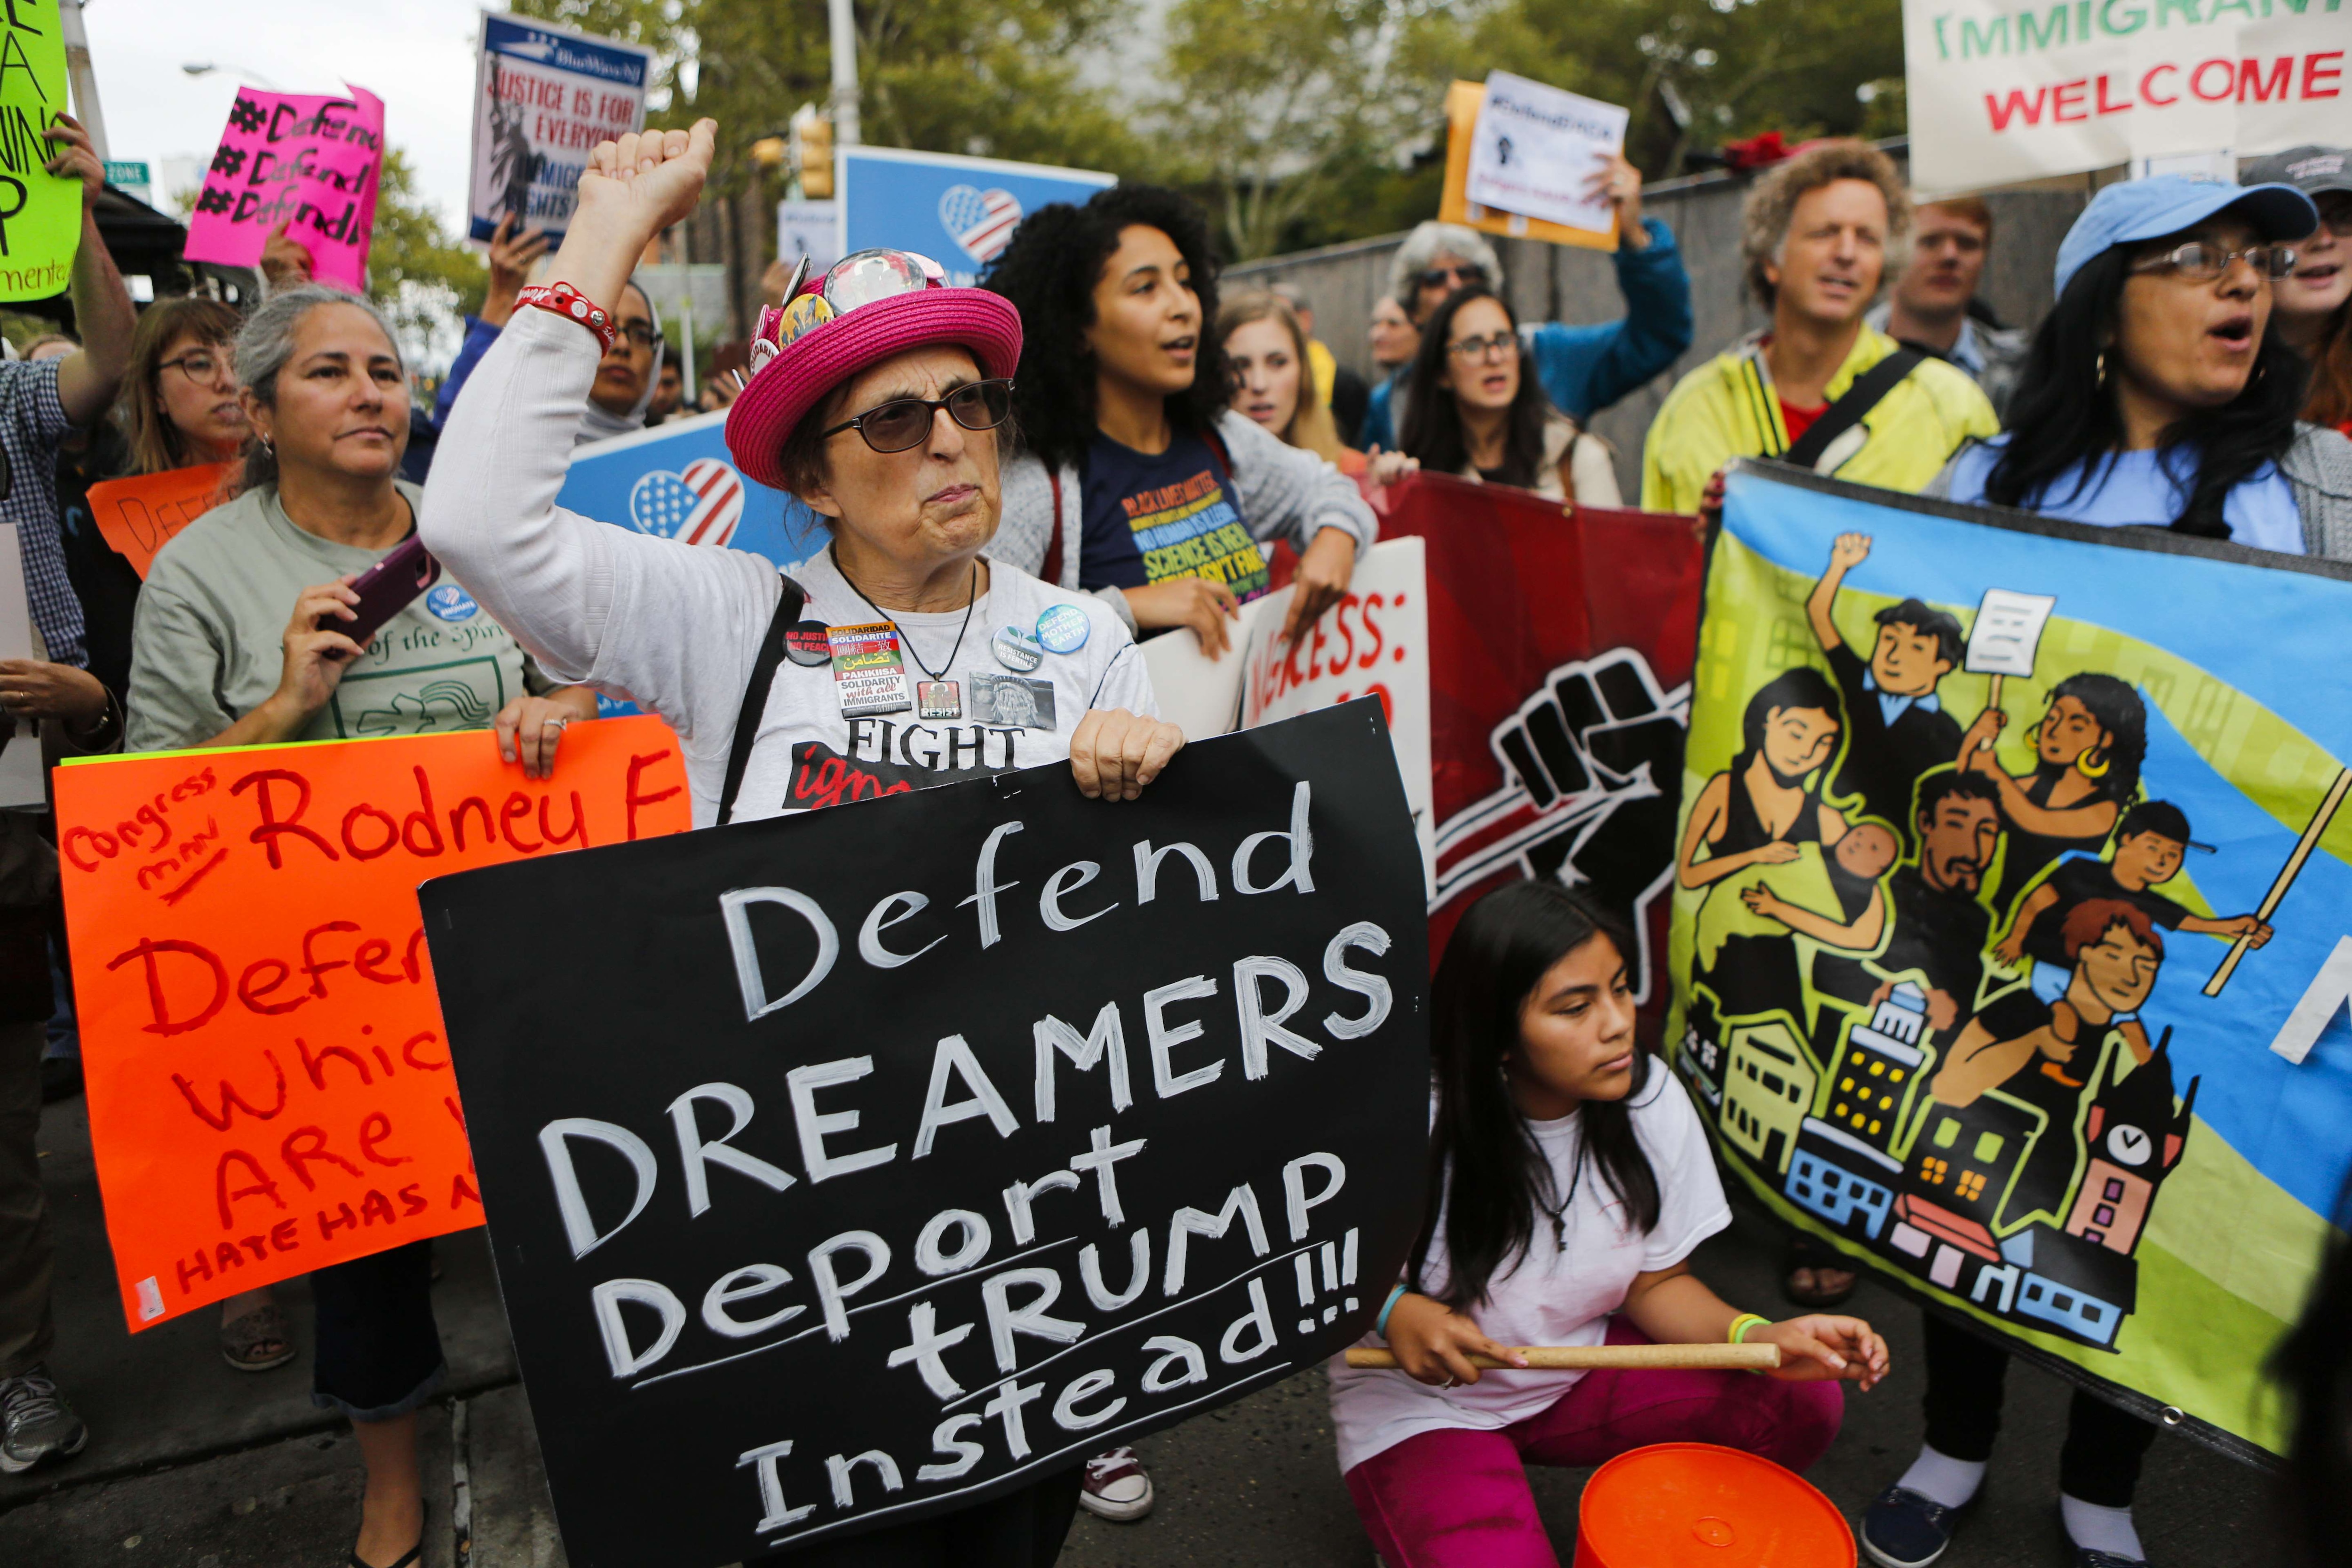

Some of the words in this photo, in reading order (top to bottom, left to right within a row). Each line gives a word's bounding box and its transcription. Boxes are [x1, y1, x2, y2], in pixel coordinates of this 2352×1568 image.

[1985, 50, 2344, 133] WELCOME
[572, 88, 593, 117] IS
[599, 93, 635, 125] FOR
[211, 145, 369, 193] #Defend
[1121, 491, 1160, 517] BLACK
[1158, 483, 1186, 510] LIVES
[1143, 537, 1211, 579] SCIENCE
[1203, 532, 1226, 558] IS
[831, 625, 890, 636] SOLIDARIDAD
[1038, 608, 1078, 631] DEFEND
[1041, 616, 1085, 641] MOTHER
[368, 630, 393, 665] of
[403, 626, 440, 651] the
[452, 621, 505, 652] Spiri
[786, 631, 799, 640] NO
[801, 631, 826, 641] JUSTI
[790, 641, 802, 650] NO
[832, 631, 892, 644] SOLIDARITE
[1051, 626, 1086, 647] EARTH
[843, 652, 891, 670] تضامن
[998, 644, 1038, 664] RESISTANCE
[841, 676, 902, 690] SOLIDARITY
[842, 667, 898, 680] PAKIKIISA
[843, 692, 906, 707] IMMIGRANTS
[847, 686, 873, 698] with
[876, 682, 897, 694] all
[921, 707, 959, 716] RESIST
[844, 718, 1026, 771] FIGHT
[229, 764, 589, 870] Rodney
[719, 780, 1315, 1023] Defend
[538, 921, 1393, 1259] DREAMERS
[176, 1218, 298, 1294] HATE
[318, 1183, 428, 1241] HAS
[592, 1125, 1148, 1379] Deport
[888, 1151, 1347, 1402] tRUMP
